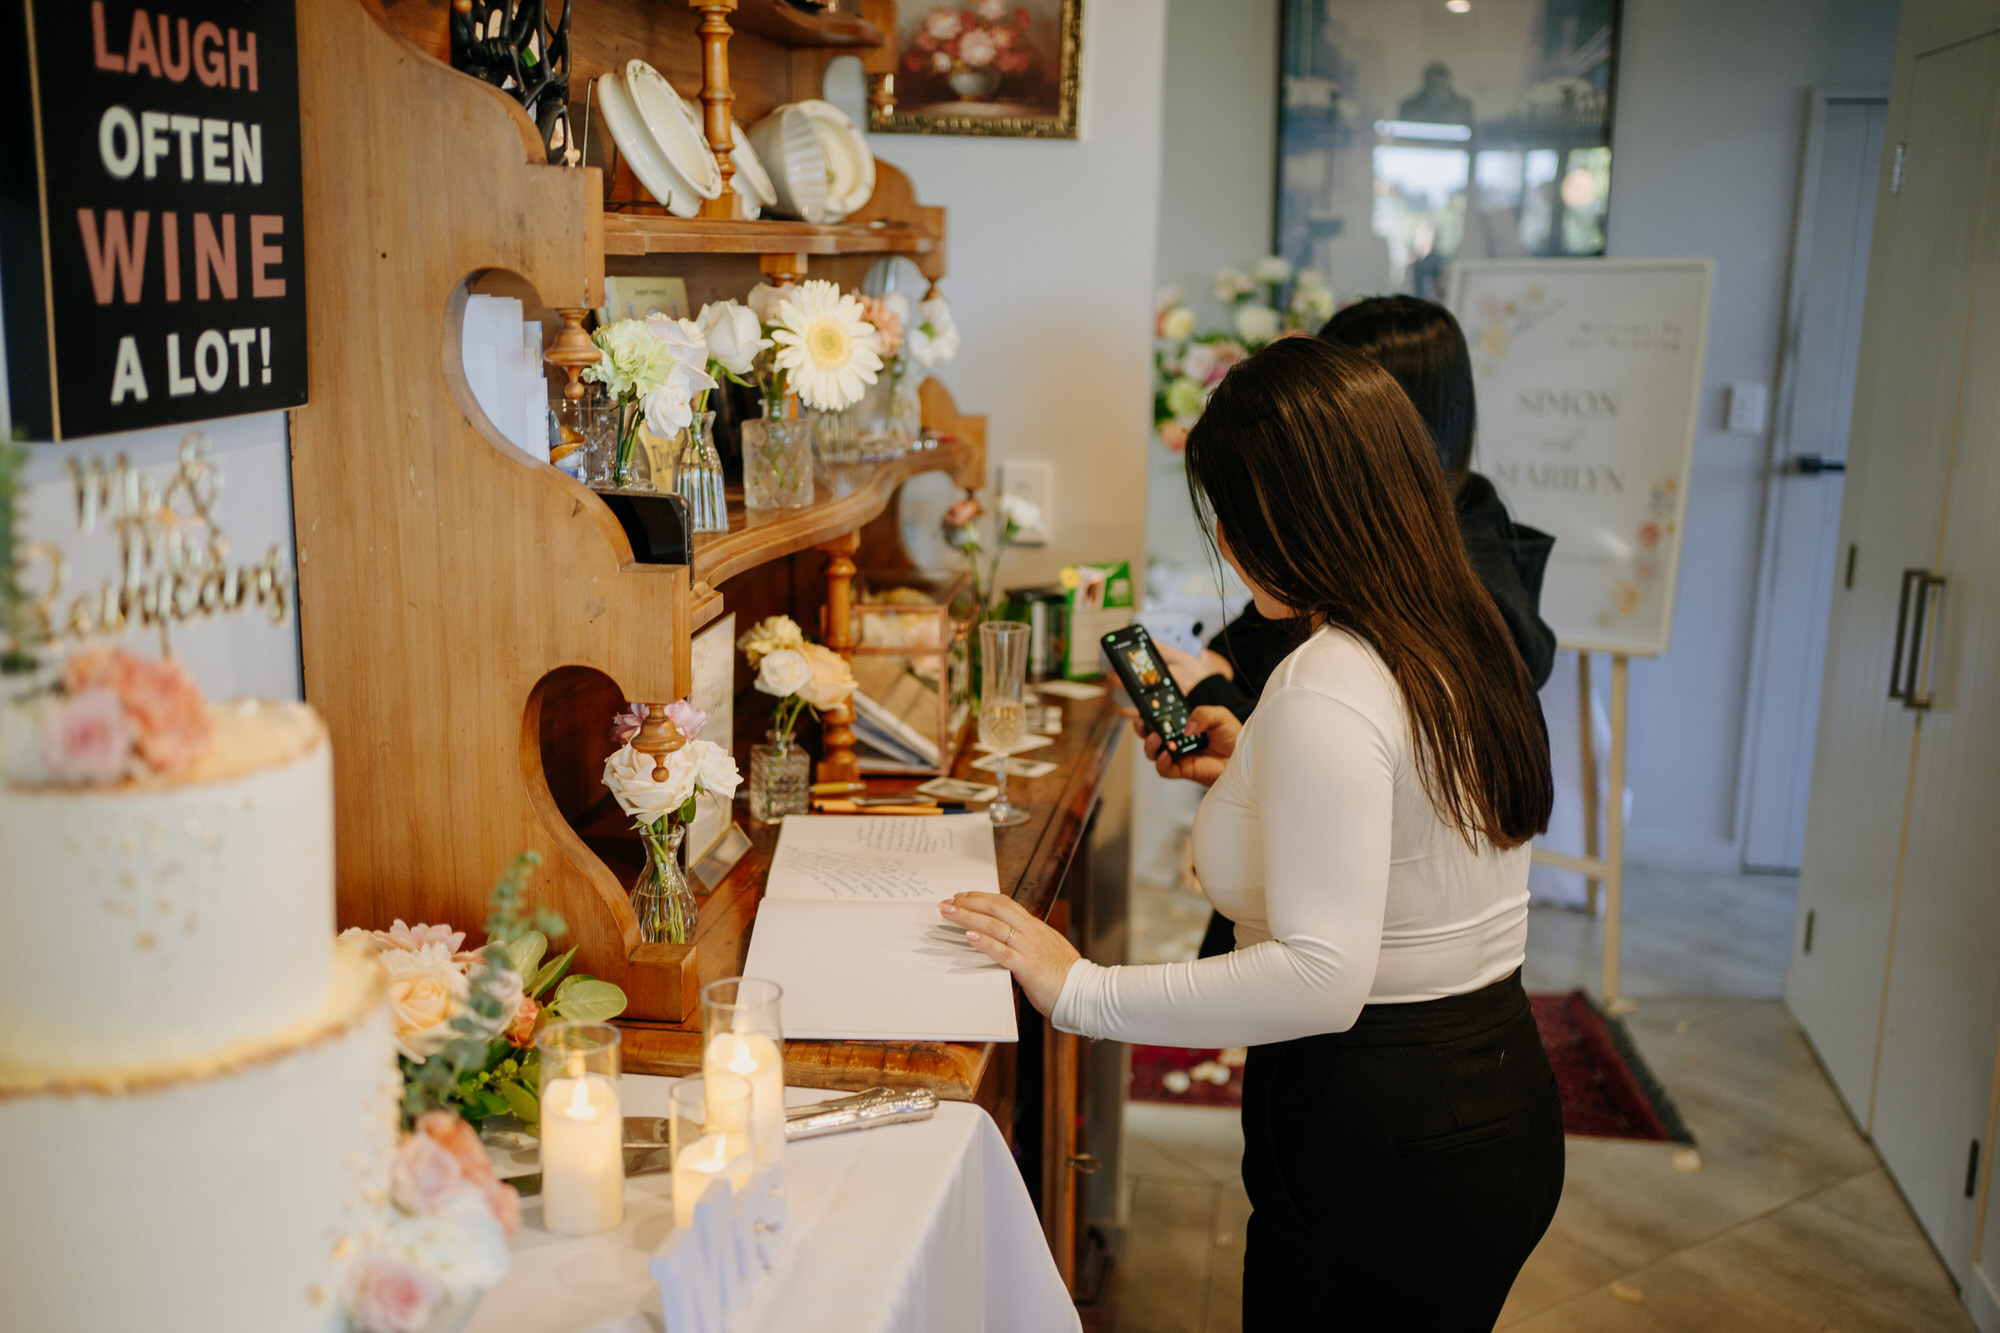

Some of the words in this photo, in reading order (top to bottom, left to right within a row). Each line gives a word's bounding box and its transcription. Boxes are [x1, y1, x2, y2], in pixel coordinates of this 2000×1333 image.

[91, 0, 259, 92] LAUGH
[99, 105, 263, 184] OFTEN
[76, 208, 287, 305] WINE
[110, 336, 148, 405] A
[166, 327, 272, 397] LOT!
[1517, 389, 1621, 419] SIMON
[1495, 460, 1626, 495] MARILYN
